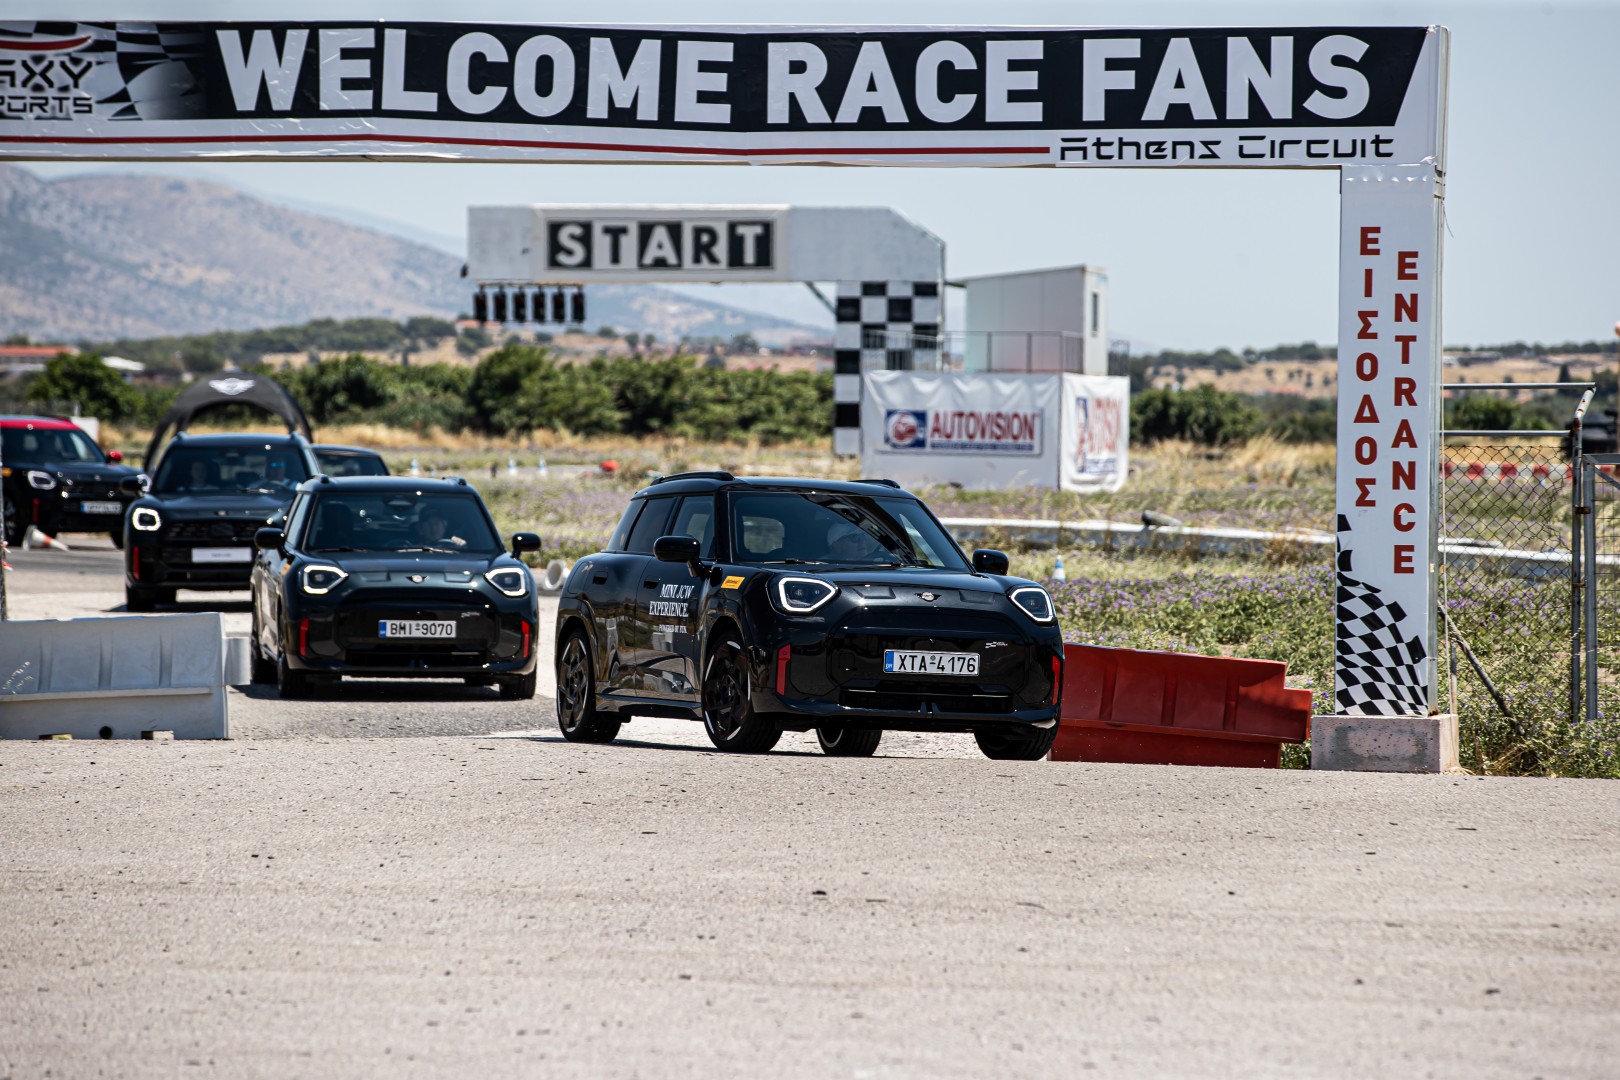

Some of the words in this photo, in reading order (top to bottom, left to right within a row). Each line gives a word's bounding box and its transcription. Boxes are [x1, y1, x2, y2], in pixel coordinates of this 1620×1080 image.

[215, 27, 735, 125] WELCOME
[766, 39, 1044, 124] RACE
[1082, 33, 1371, 121] FANS
[1238, 134, 1395, 159] Circuit
[555, 224, 763, 266] START
[1353, 226, 1381, 508] ΕΙΣΟΔΟΣ
[930, 411, 1036, 441] AUTOVISION
[1391, 250, 1419, 574] ENTRANCE
[660, 584, 678, 598] MINI
[676, 585, 694, 599] JCW
